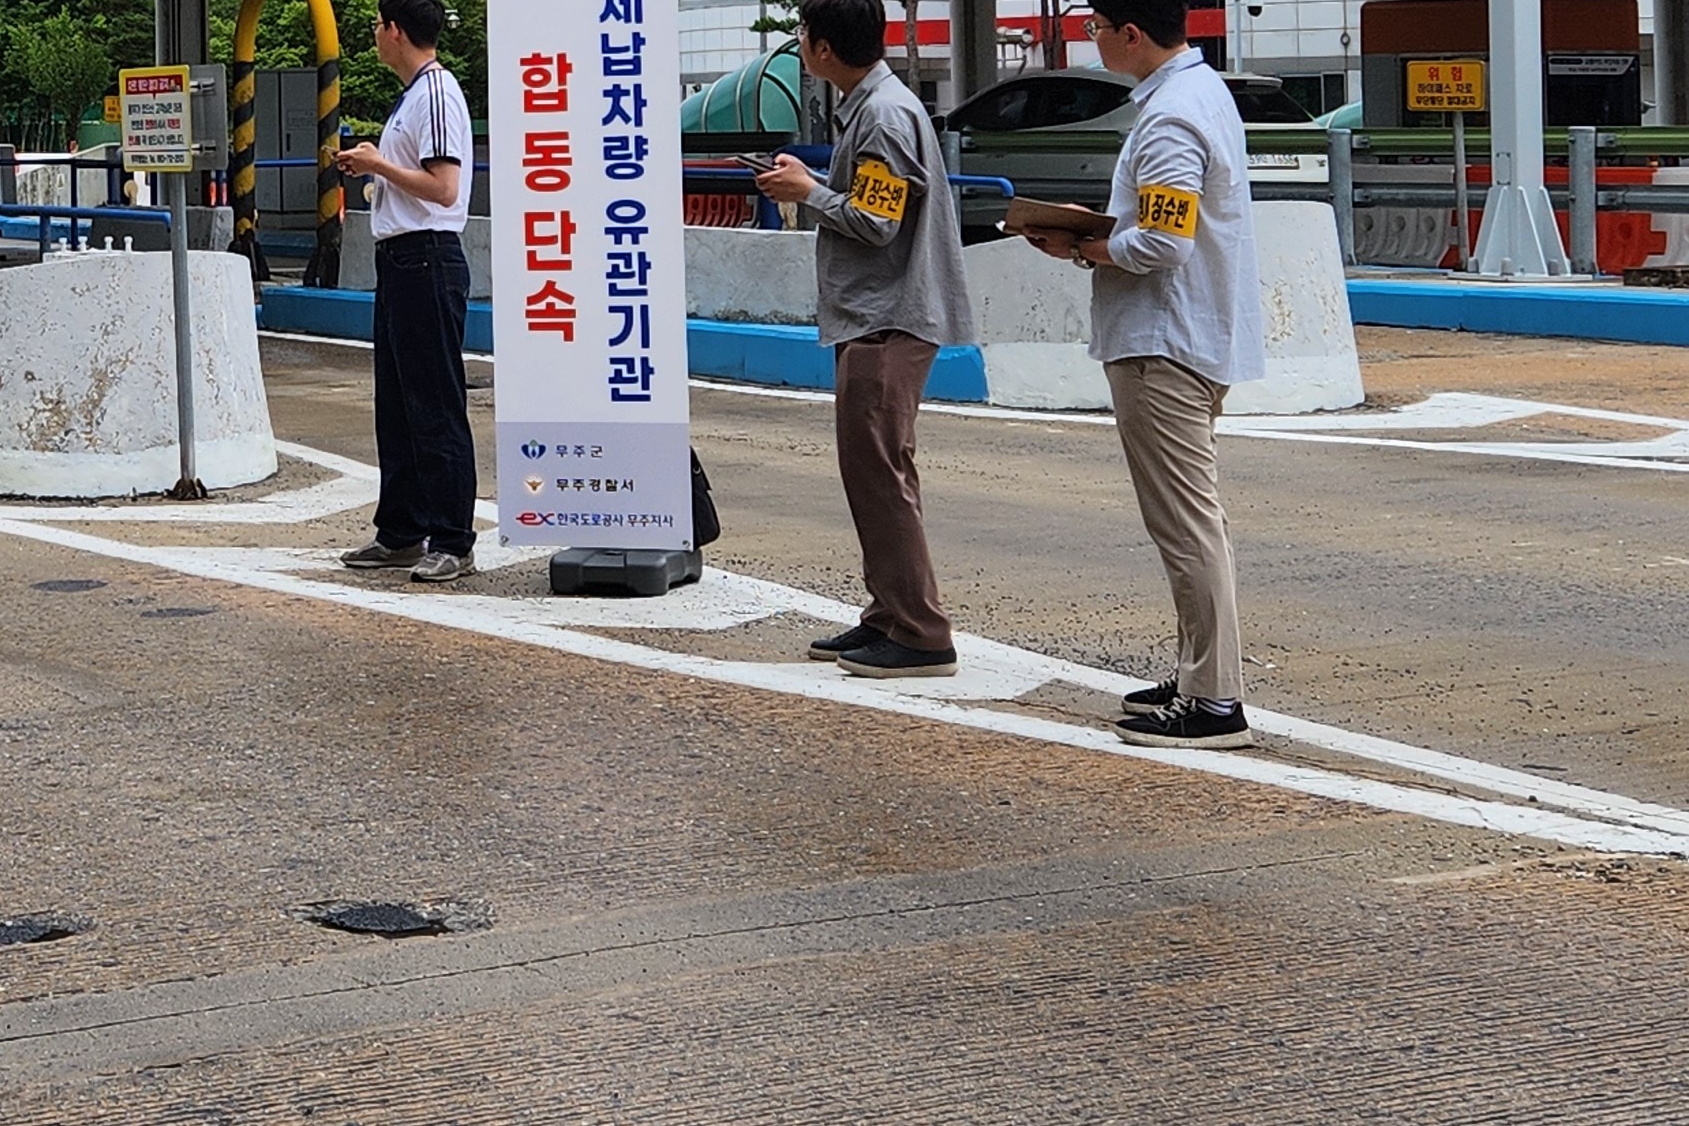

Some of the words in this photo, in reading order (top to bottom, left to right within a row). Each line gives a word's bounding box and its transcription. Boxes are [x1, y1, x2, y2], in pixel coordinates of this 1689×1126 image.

[1417, 83, 1451, 94] 하이패스
[519, 51, 577, 343] 합동단속
[605, 199, 653, 403] 유관기관
[555, 445, 603, 459] 무주군
[556, 478, 635, 492] 무주경찰서
[516, 512, 555, 526] ex
[557, 513, 624, 527] 한국도로공사
[627, 514, 674, 528] 무주지사
